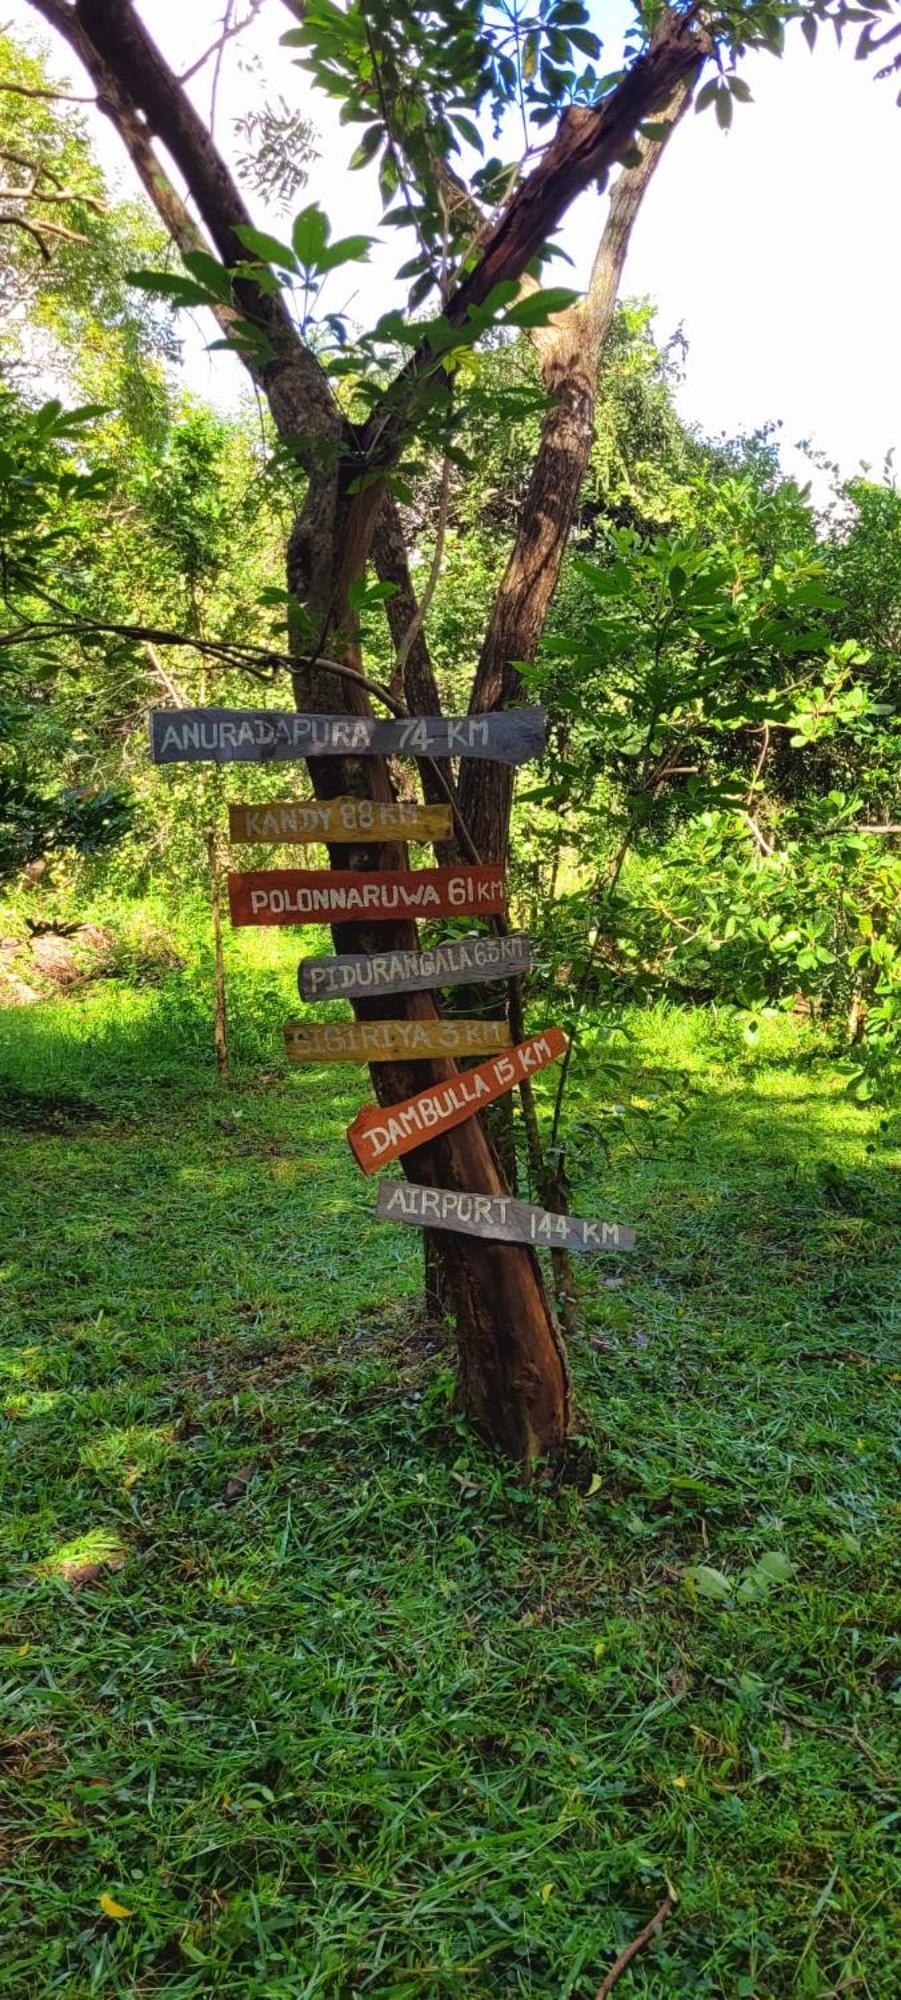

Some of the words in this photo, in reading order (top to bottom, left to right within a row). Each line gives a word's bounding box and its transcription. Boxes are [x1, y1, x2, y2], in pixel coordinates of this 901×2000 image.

[160, 719, 370, 753] ANURADAPURA
[399, 719, 433, 751] 74
[448, 719, 488, 749] KM
[246, 807, 331, 835] KANDY
[340, 800, 374, 829] 88
[380, 802, 417, 825] KM
[251, 885, 440, 914] POLONNARUWA
[448, 878, 473, 905] 61
[478, 881, 503, 902] KM
[310, 951, 472, 992] PIDURANGALA
[501, 938, 522, 961] KM
[446, 1025, 462, 1046] 3
[466, 1023, 499, 1045] KM
[362, 1074, 490, 1157] DAMBULLA
[492, 1057, 516, 1085] 15
[517, 1038, 551, 1072] KM
[530, 1213, 571, 1239] 144
[583, 1223, 619, 1244] KM
